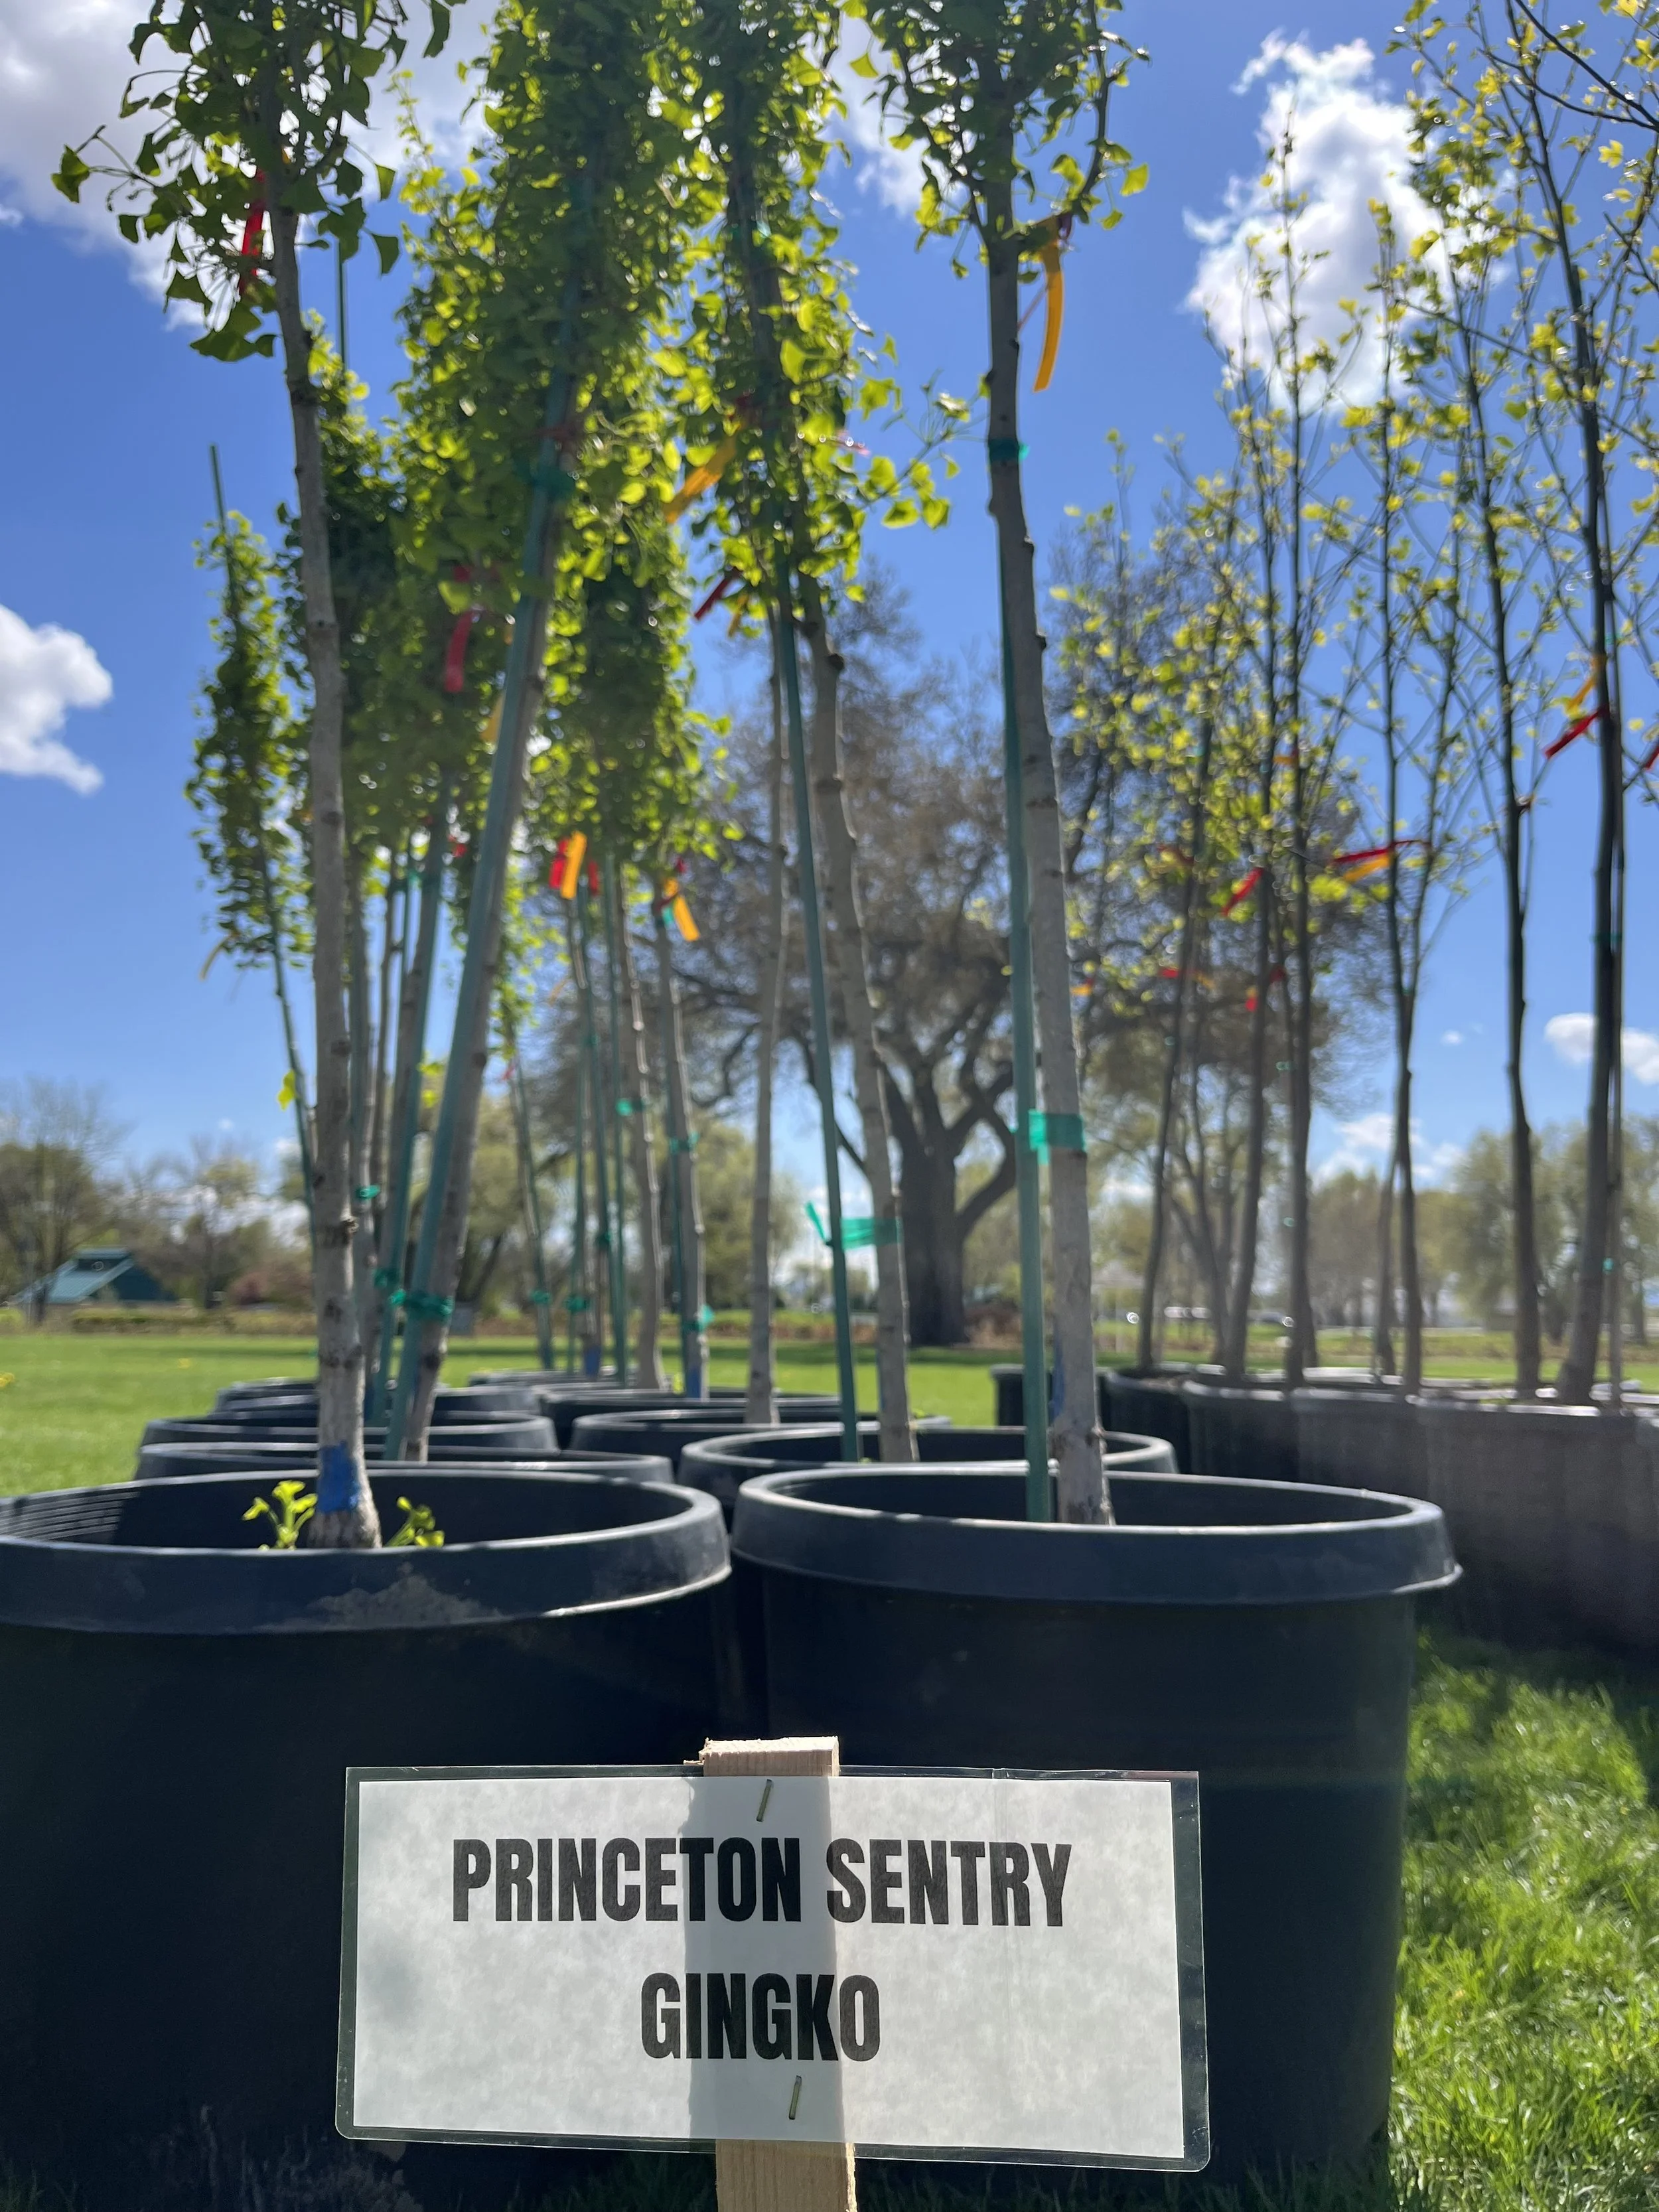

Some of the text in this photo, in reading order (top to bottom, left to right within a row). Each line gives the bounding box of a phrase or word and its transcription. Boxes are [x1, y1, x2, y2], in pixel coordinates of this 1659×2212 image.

[453, 1836, 1072, 1927] PRINCETON SENTRY
[641, 1972, 881, 2062] GINGKO
